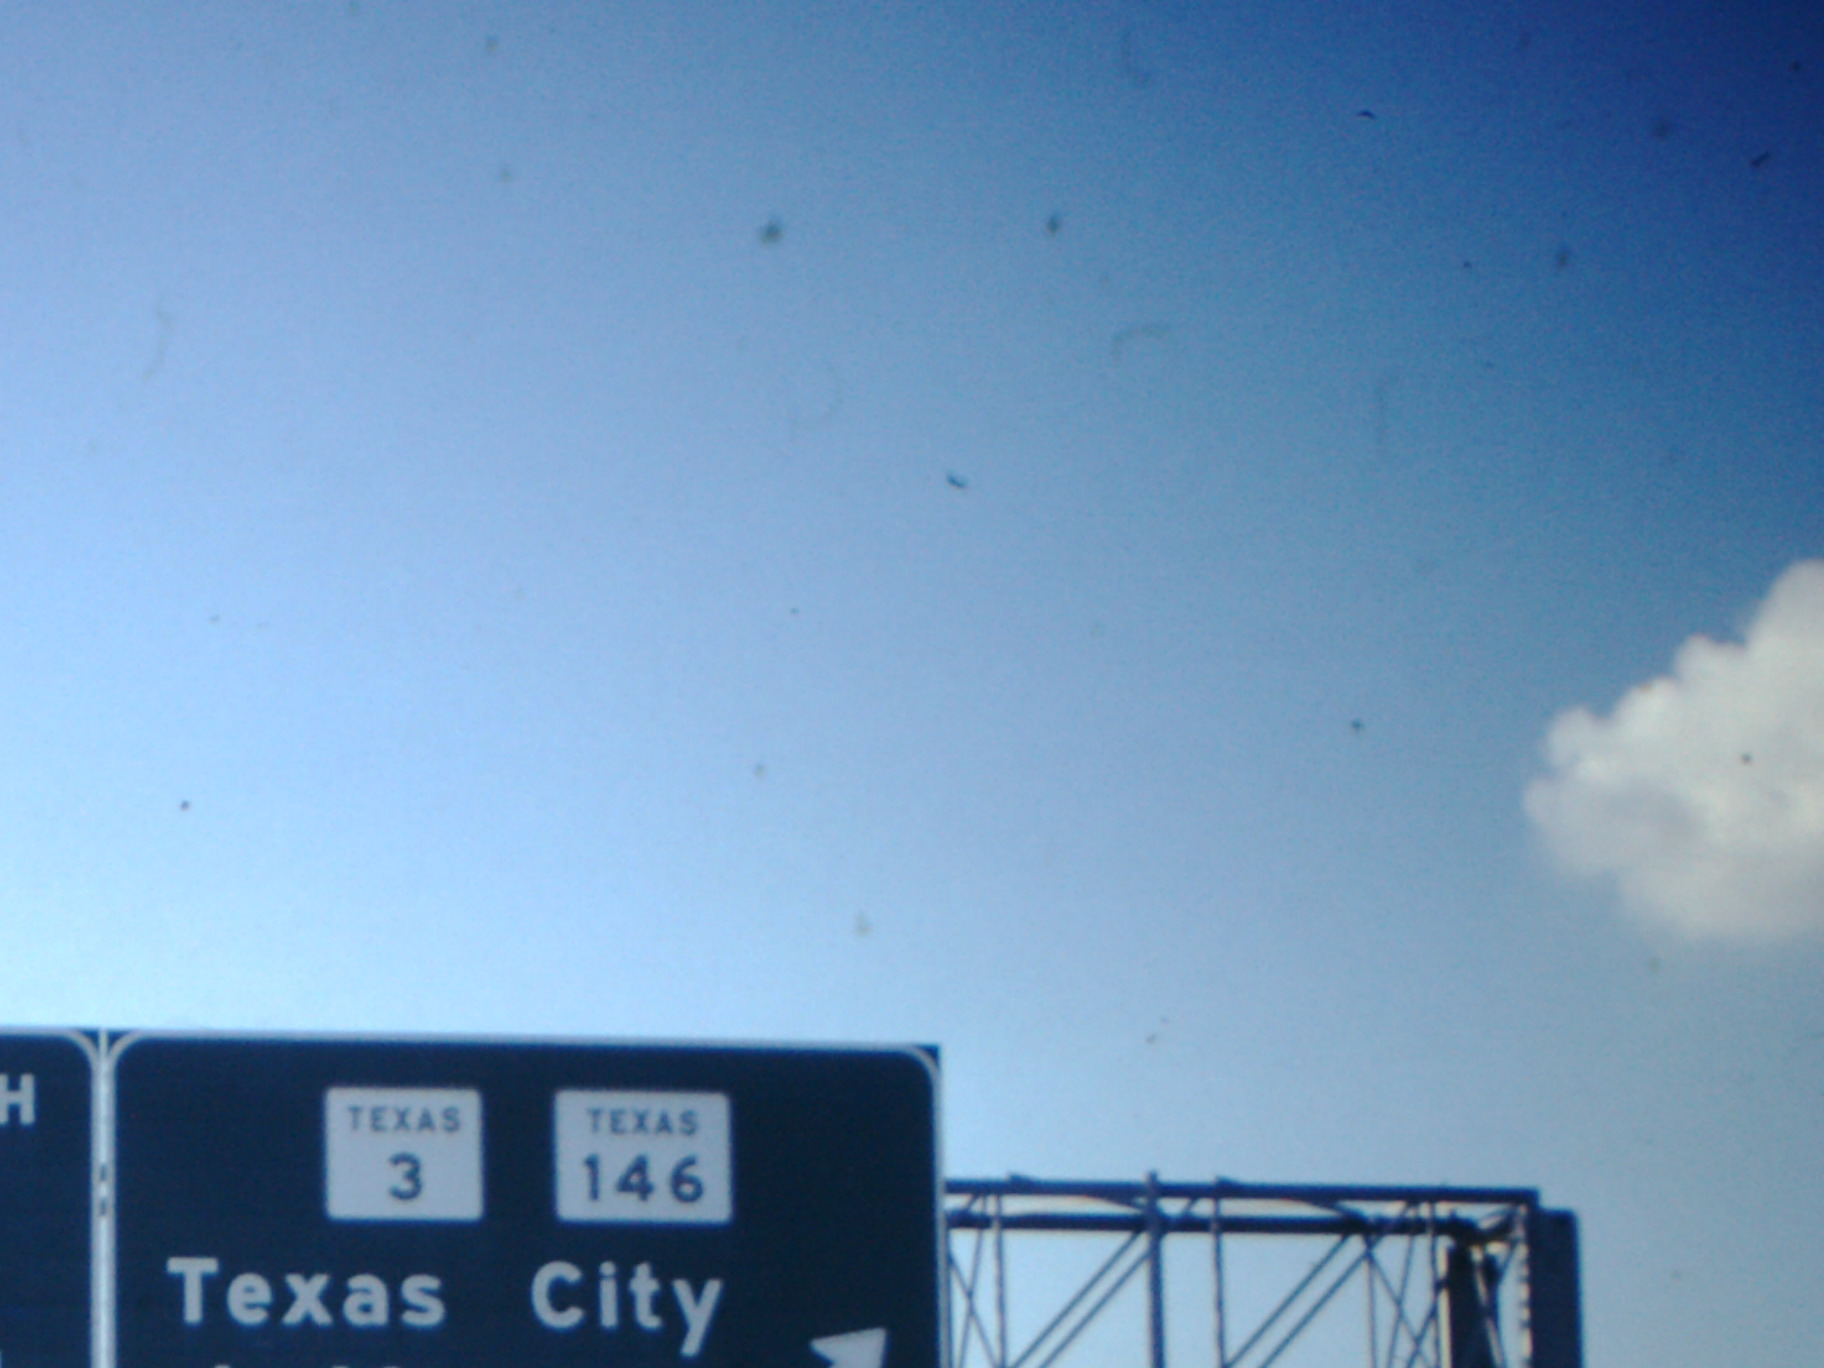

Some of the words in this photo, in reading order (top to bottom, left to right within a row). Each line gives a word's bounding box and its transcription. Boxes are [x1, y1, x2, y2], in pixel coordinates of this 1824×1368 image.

[348, 1105, 462, 1135] TEXAS
[588, 1107, 699, 1138] TEXAS
[389, 1152, 424, 1203] 3
[584, 1154, 705, 1205] 146
[166, 1256, 445, 1327] Texas
[531, 1260, 722, 1357] City
